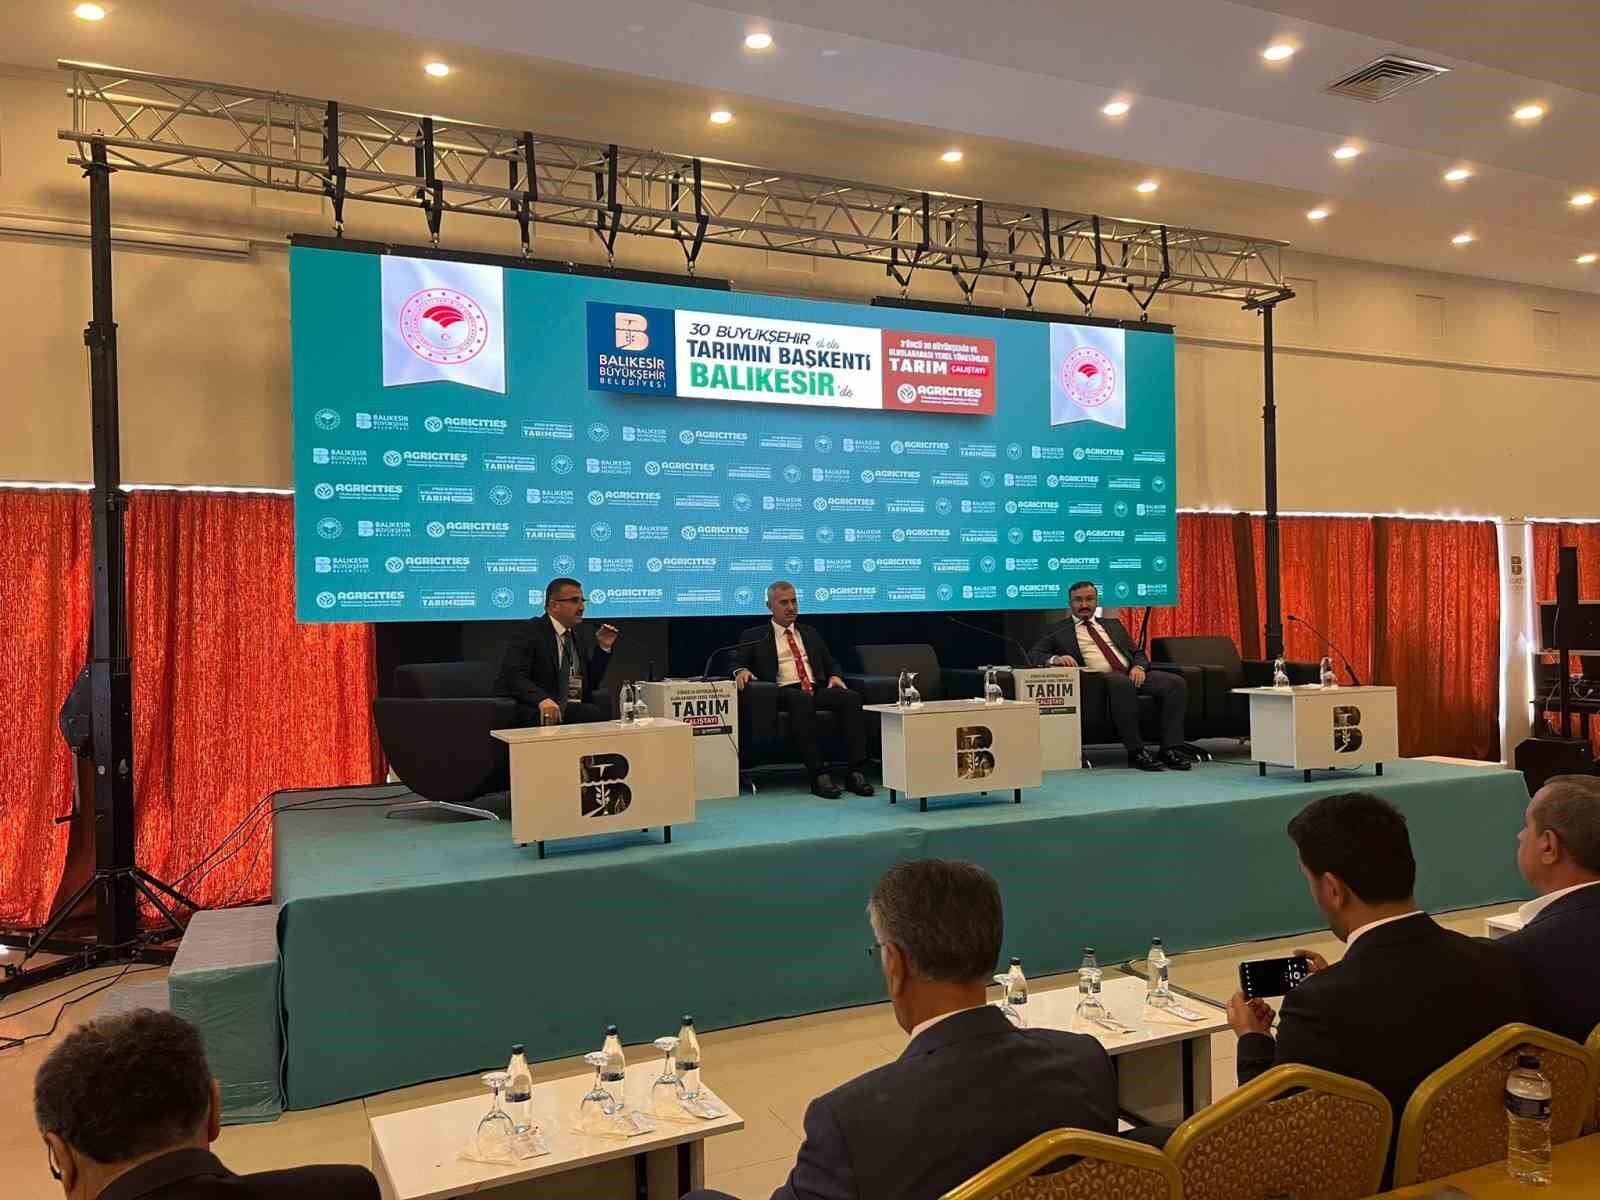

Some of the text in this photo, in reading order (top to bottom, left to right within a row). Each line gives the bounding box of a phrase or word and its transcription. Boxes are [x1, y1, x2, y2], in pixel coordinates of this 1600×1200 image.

[689, 322, 711, 336] 30
[716, 326, 811, 345] BÜYÜKŞEHİR
[686, 339, 871, 371] TARIMIN BAŞKENTİ
[600, 354, 665, 370] BALIKESİR
[889, 358, 947, 375] TARIM
[600, 366, 665, 381] BÜYÜKŞEHİR
[917, 386, 982, 398] AGRICITIES
[444, 417, 507, 428] AGRICITIES
[404, 451, 468, 461] AGRICITIES
[336, 484, 403, 493] AGRICITIES
[446, 522, 510, 530] AGRICITIES
[406, 557, 470, 565] AGRICITIES
[338, 592, 404, 600] AGRICITIES
[1026, 683, 1073, 697] TARIM
[672, 699, 729, 717] TARIM
